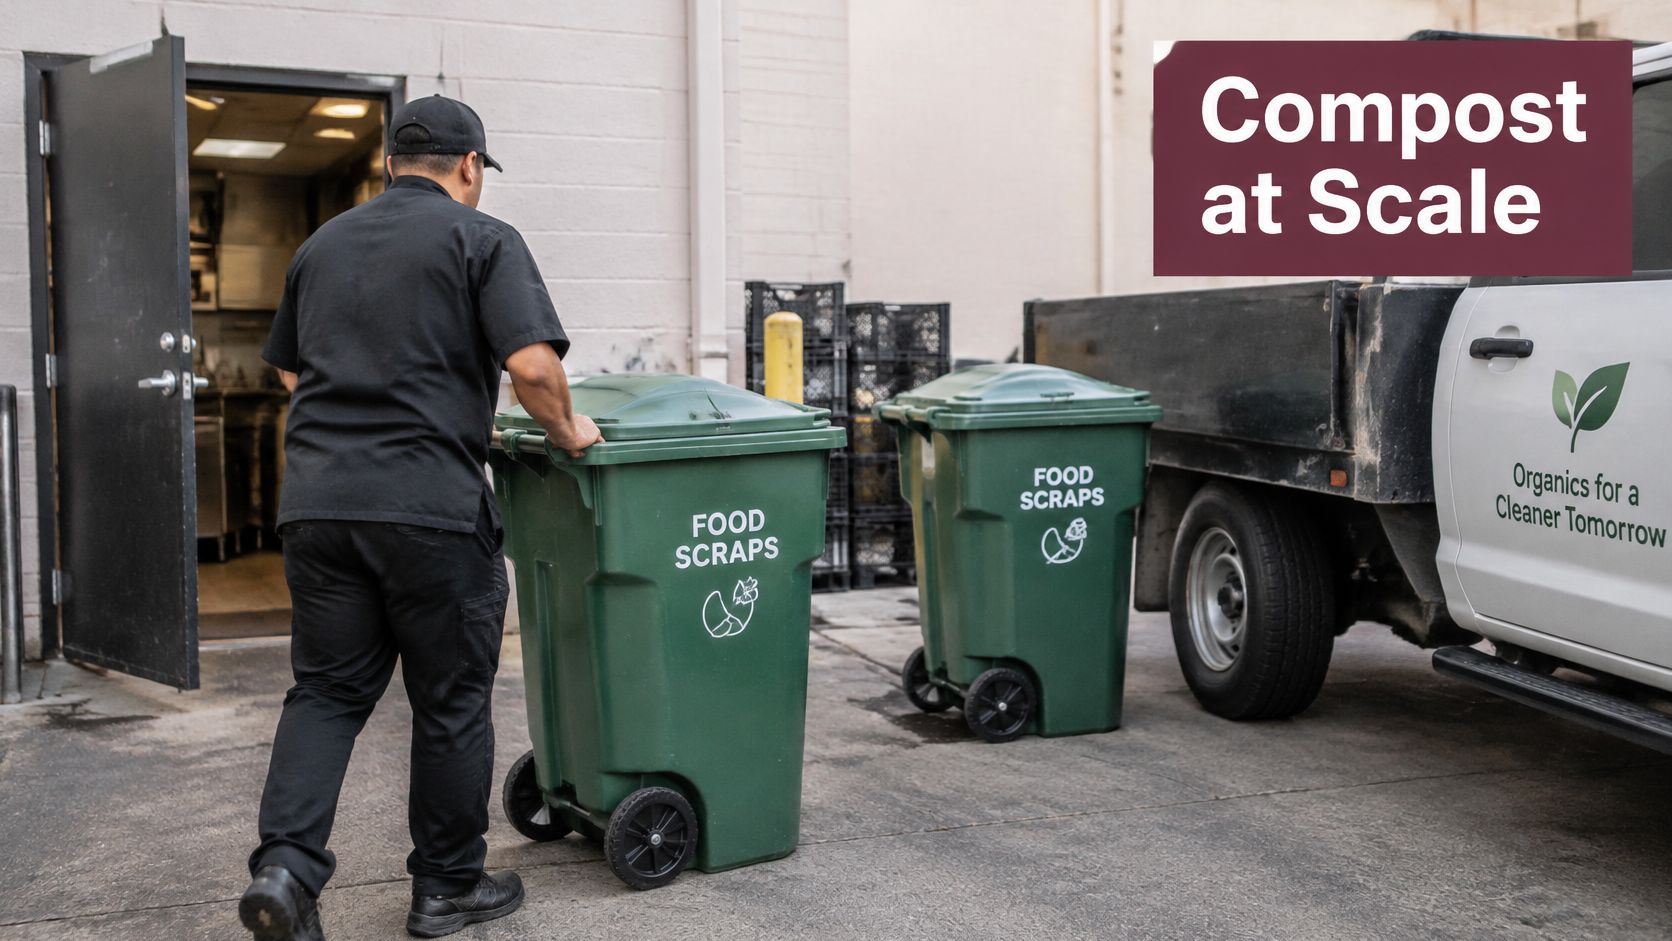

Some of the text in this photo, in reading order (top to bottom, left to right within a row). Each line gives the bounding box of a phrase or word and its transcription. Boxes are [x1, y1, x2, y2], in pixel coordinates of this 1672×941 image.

[1035, 466, 1093, 486] FOOD
[1514, 463, 1639, 506] Organics for a
[1021, 488, 1104, 510] SCRAPS
[693, 509, 764, 537] FOOD
[1496, 495, 1666, 548] Cleaner Tomorrow
[675, 537, 778, 568] SCRAPS
